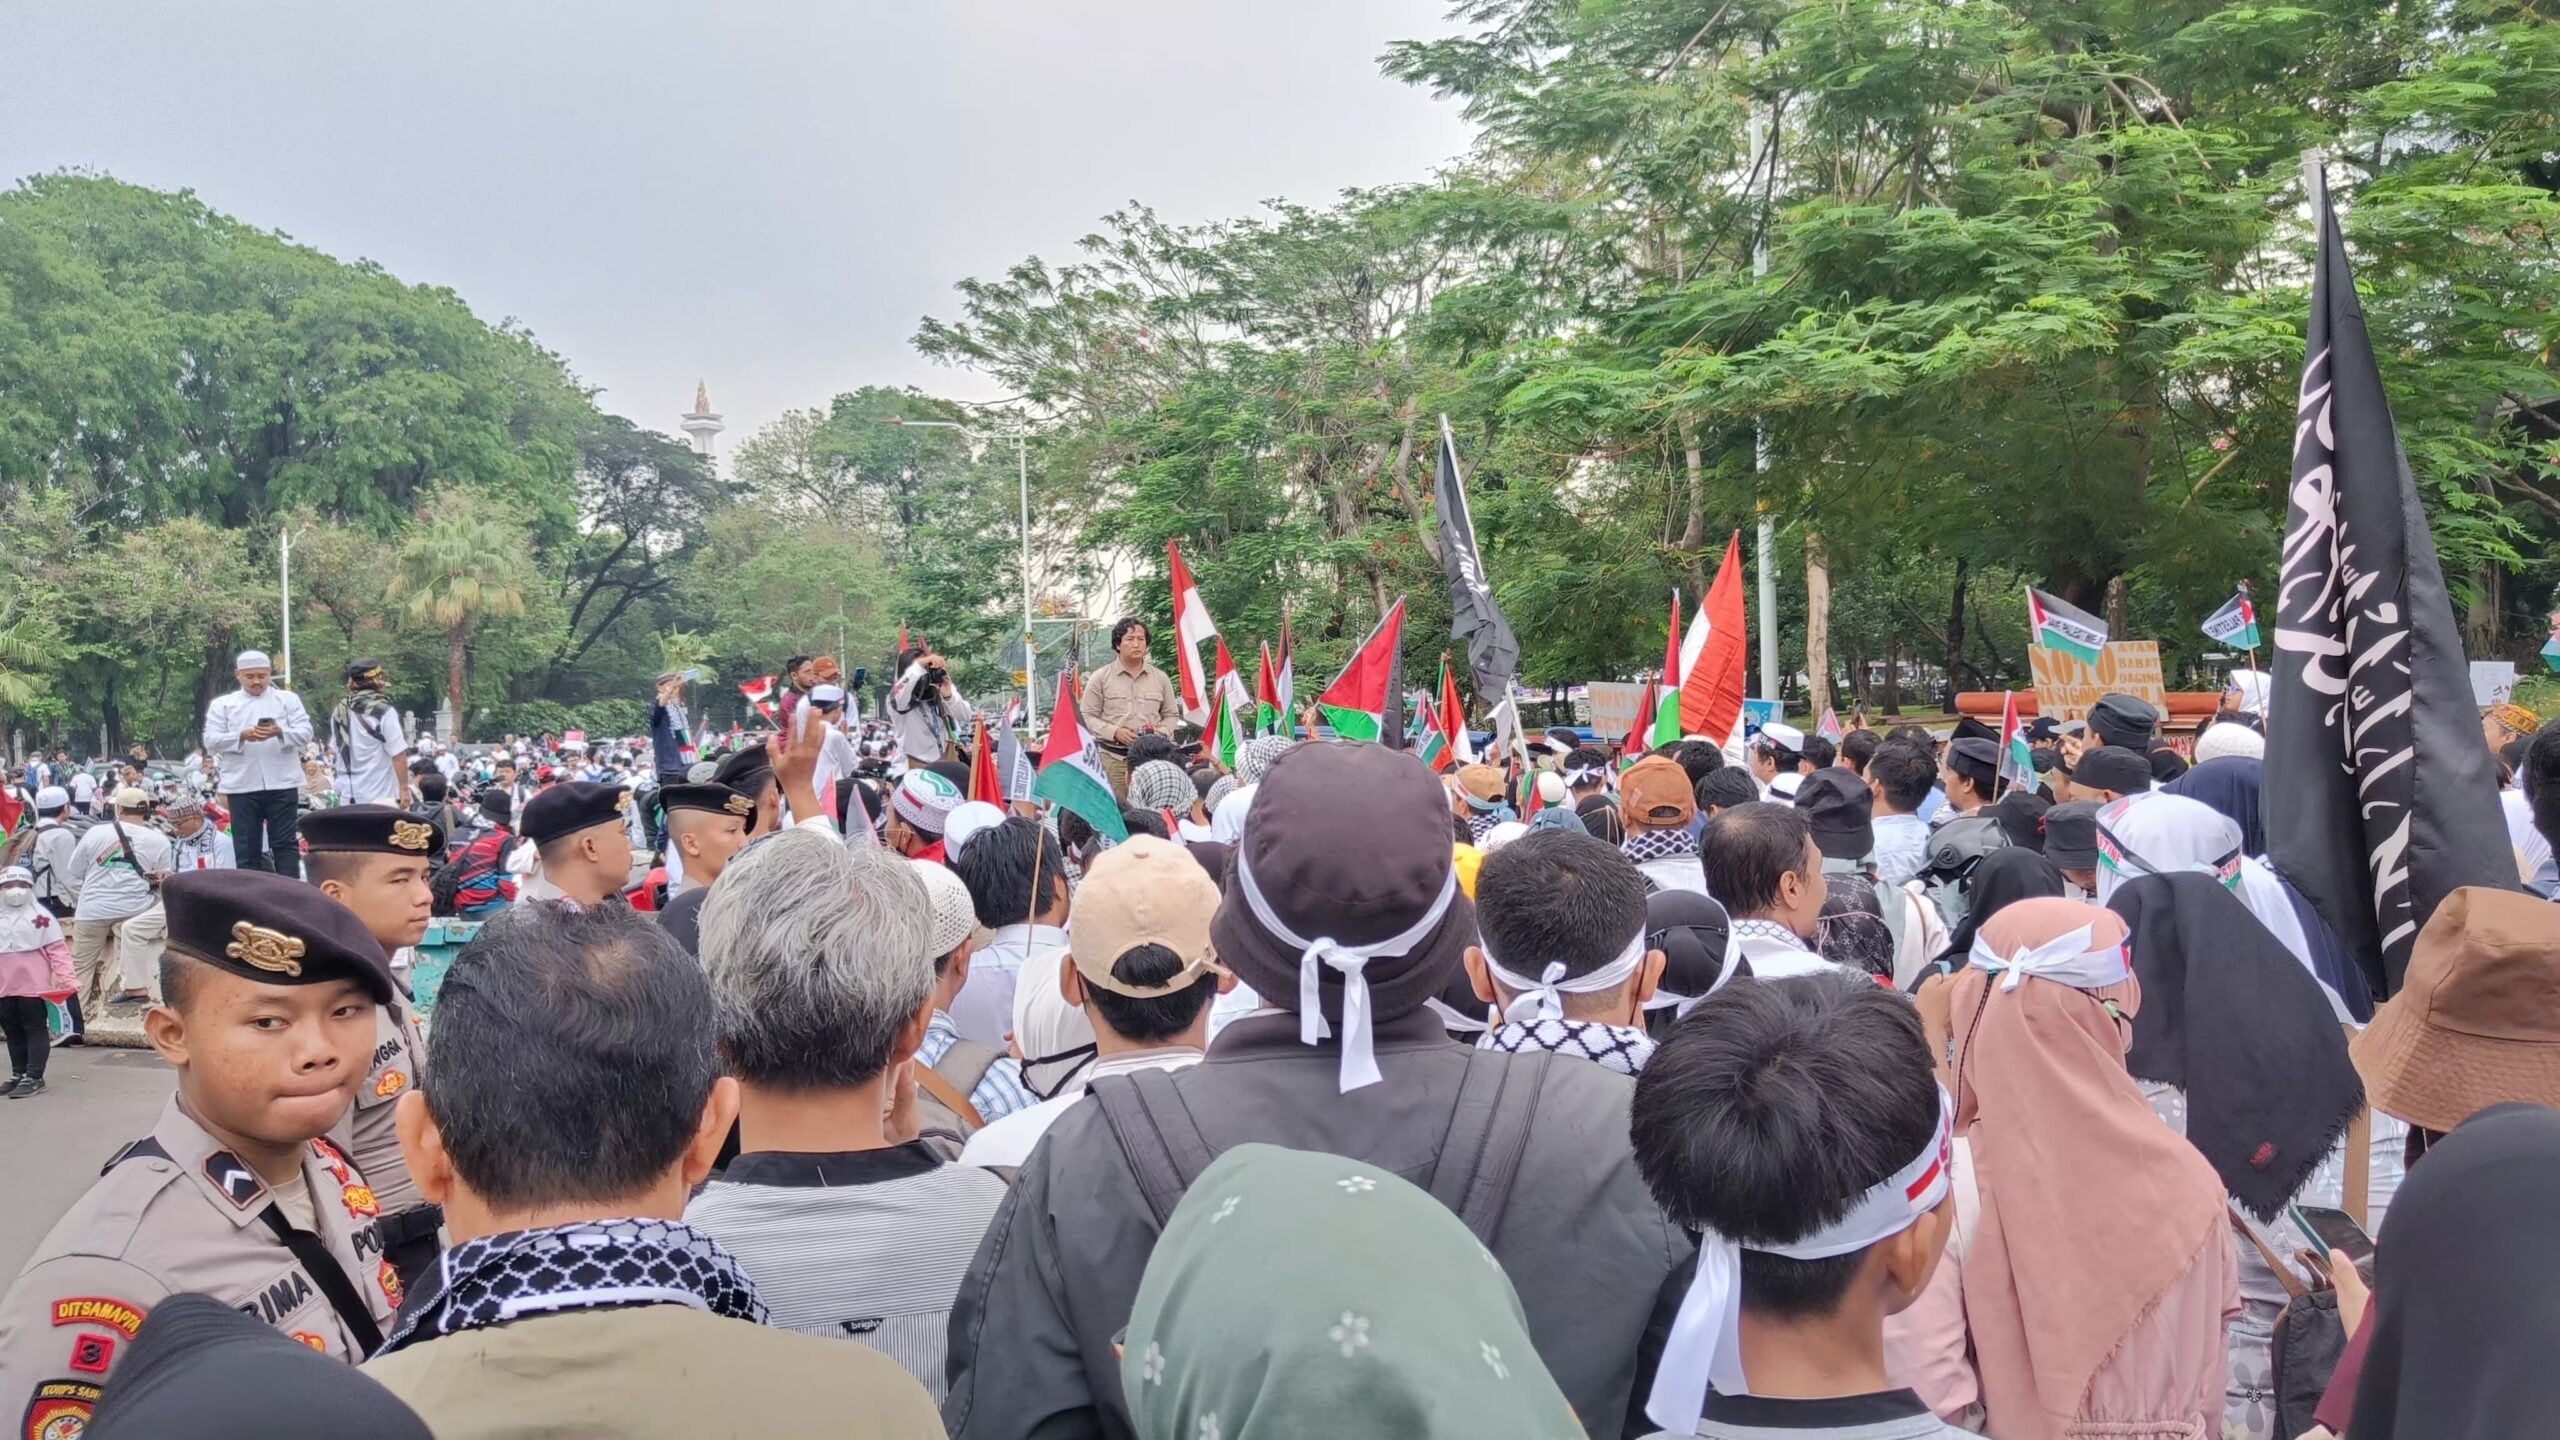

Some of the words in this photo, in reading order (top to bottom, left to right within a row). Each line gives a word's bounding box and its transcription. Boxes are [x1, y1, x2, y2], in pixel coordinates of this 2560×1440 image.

[2029, 643, 2117, 686] SOTO
[2118, 658, 2160, 668] BABAT
[369, 1037, 402, 1074] NGGA
[58, 1301, 142, 1333] DITSAMAPTA
[81, 1344, 101, 1363] 3
[41, 1384, 75, 1396] KORPS
